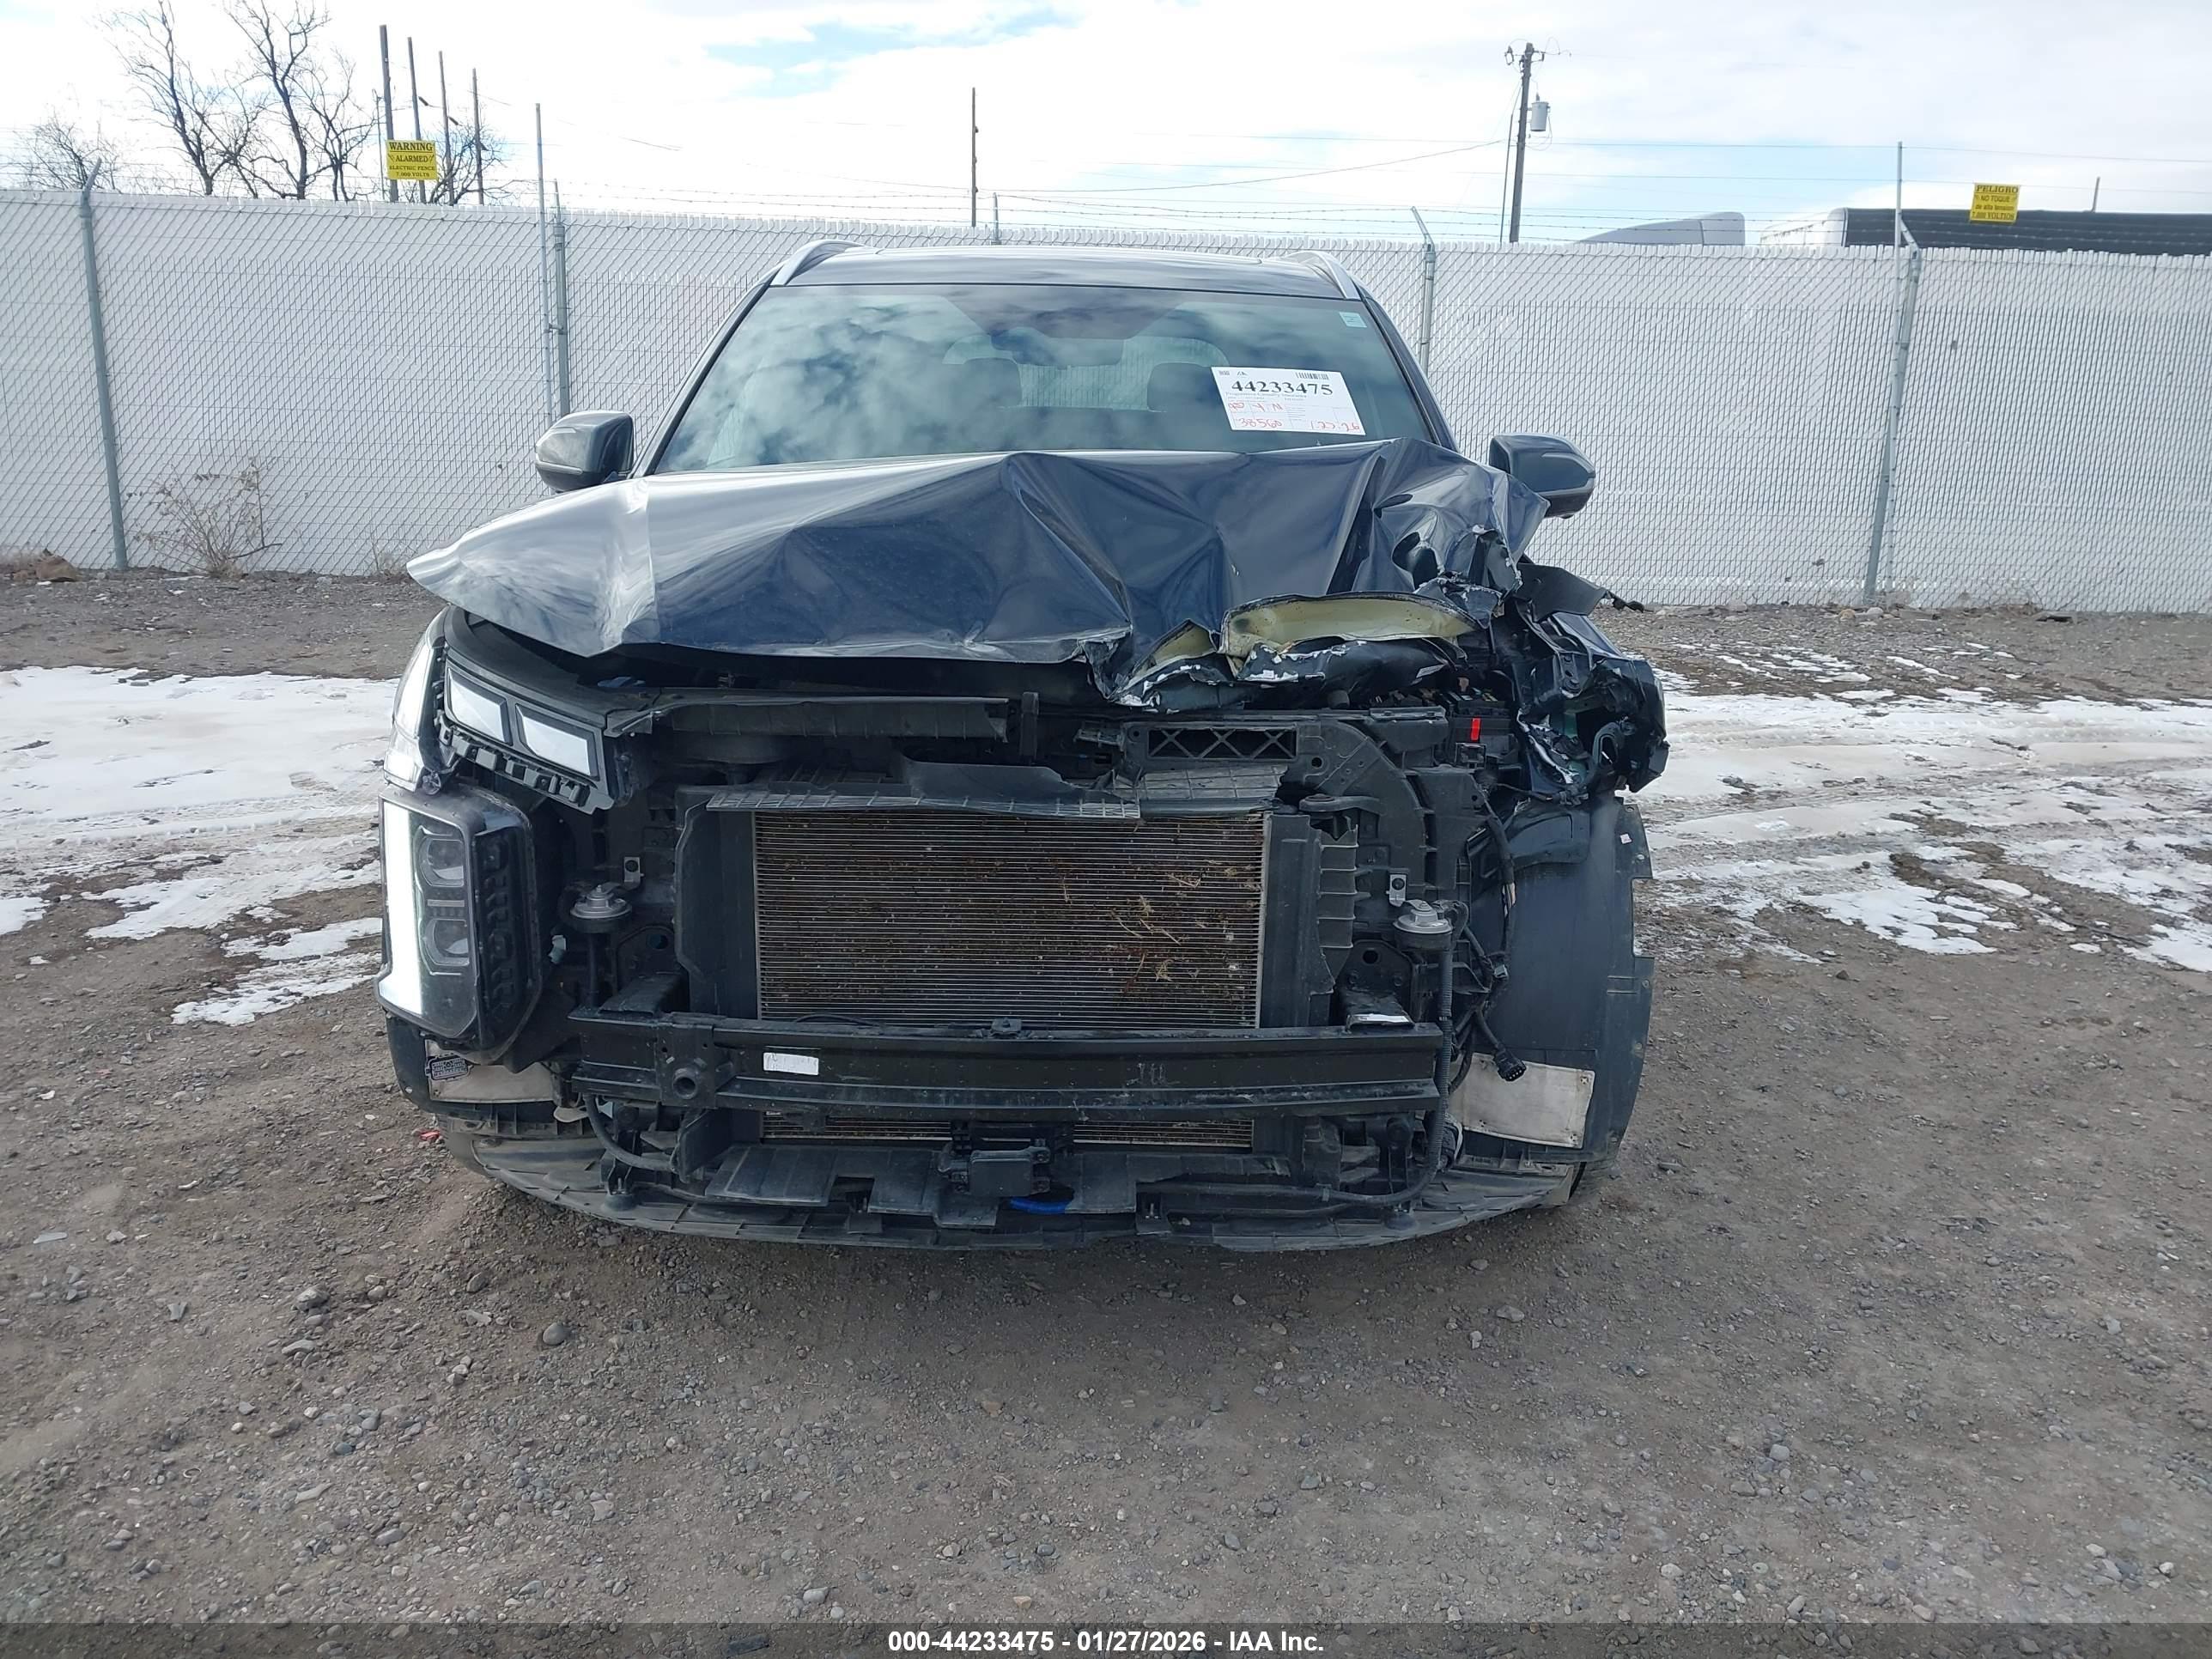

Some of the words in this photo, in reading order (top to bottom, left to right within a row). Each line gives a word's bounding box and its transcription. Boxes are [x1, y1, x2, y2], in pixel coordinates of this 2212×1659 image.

[389, 143, 433, 151] WARNING
[1977, 185, 2018, 193] PELIGRO
[1231, 380, 1334, 396] 44233475
